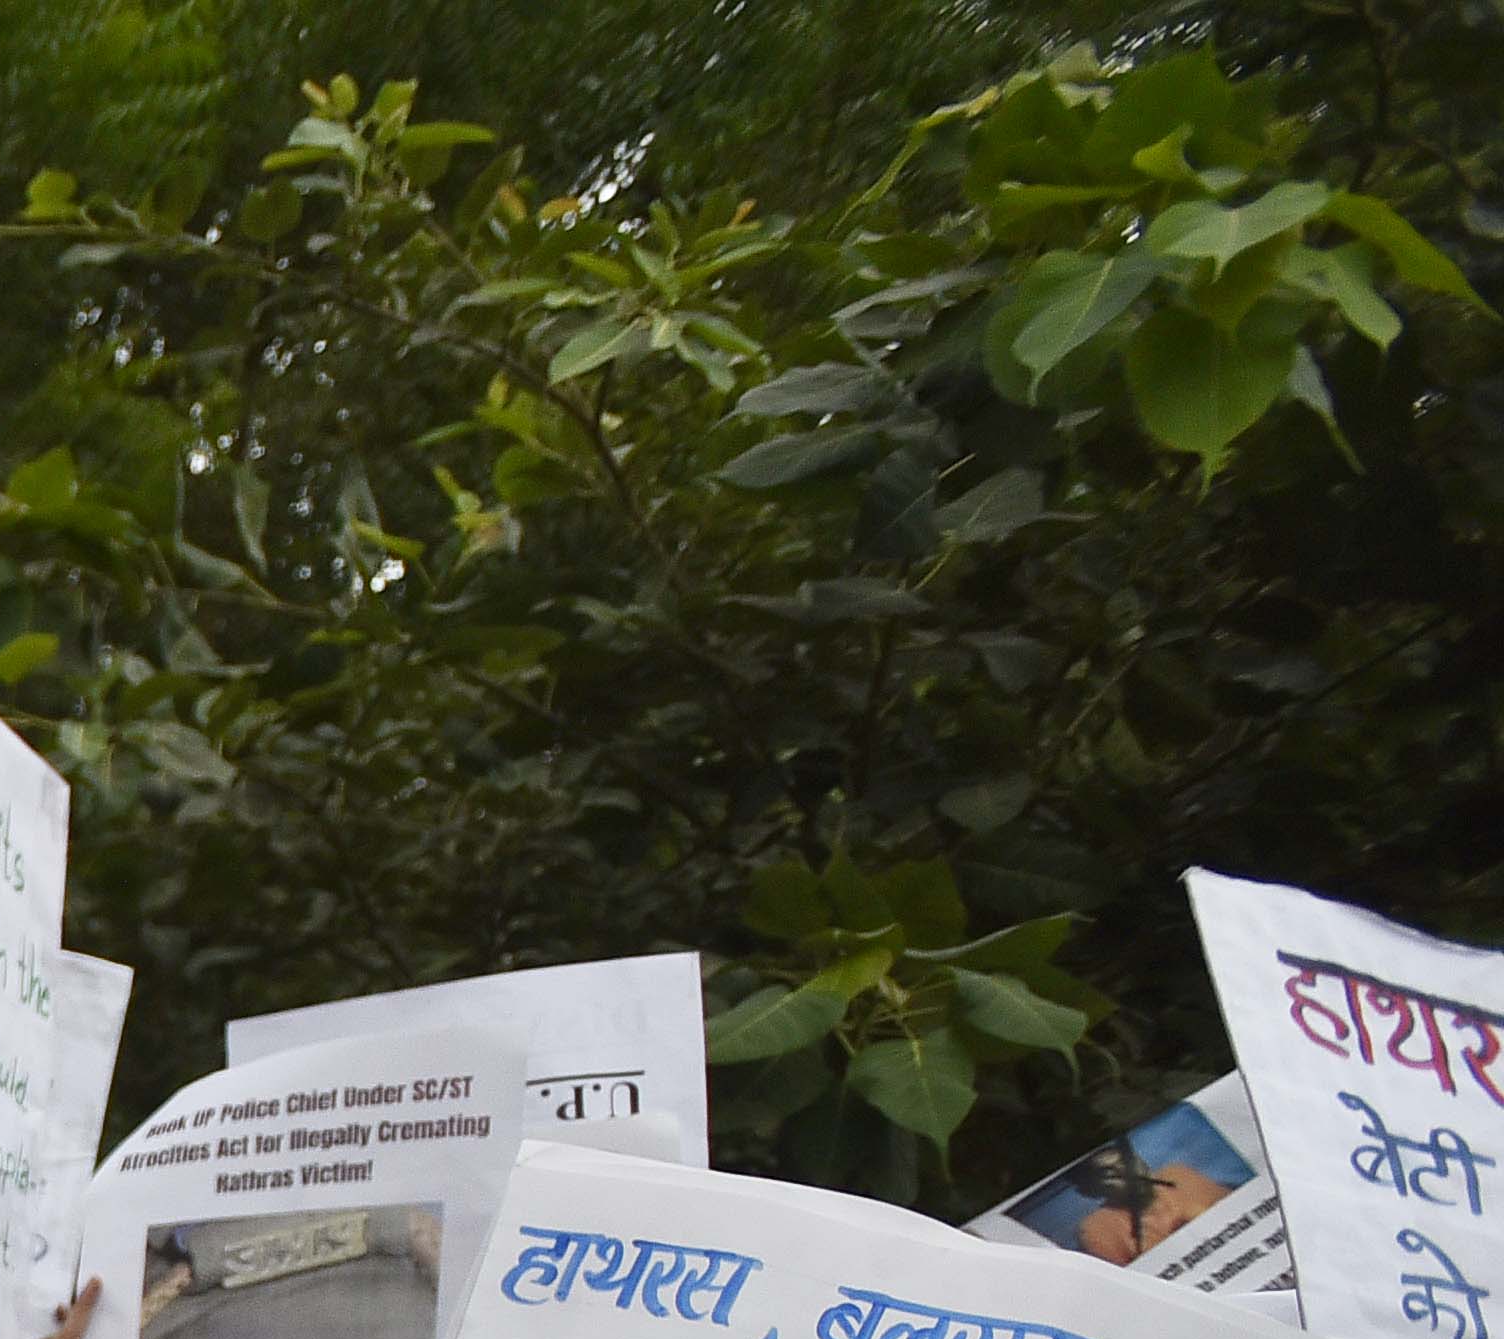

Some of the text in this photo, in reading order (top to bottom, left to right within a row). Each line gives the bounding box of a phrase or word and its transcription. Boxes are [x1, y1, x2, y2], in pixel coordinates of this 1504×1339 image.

[219, 1098, 280, 1124] Police
[286, 1087, 339, 1115] Chief
[343, 1081, 405, 1110] Under
[412, 1074, 474, 1103] SC/ST
[216, 1134, 249, 1160] Act
[254, 1129, 283, 1154] for
[377, 1113, 491, 1144] Cremating
[1337, 1091, 1496, 1216] बेटी
[300, 1158, 374, 1188] Victim!
